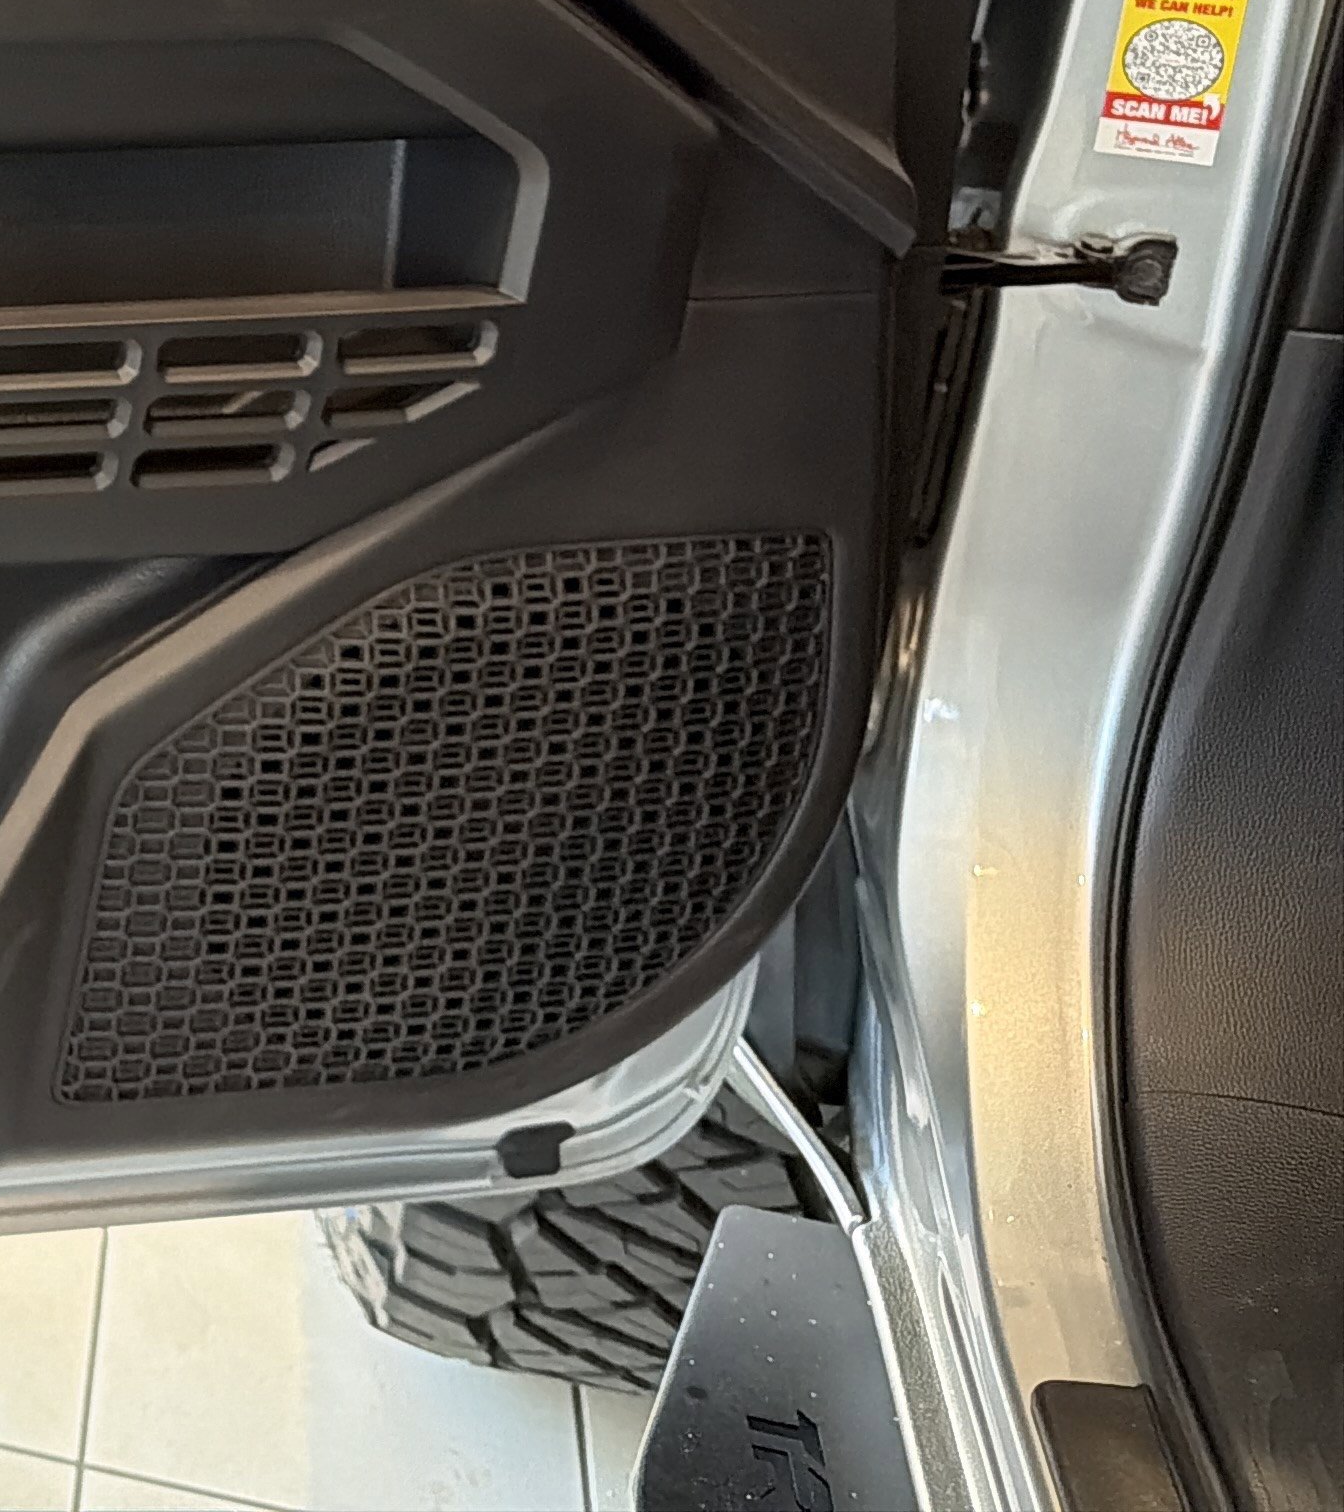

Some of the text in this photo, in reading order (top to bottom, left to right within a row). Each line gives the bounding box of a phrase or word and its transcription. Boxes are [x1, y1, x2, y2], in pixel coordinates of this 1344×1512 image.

[1161, 0, 1189, 14] CAN
[1192, 1, 1233, 18] HELP!
[1112, 98, 1208, 124] SCAN ME!
